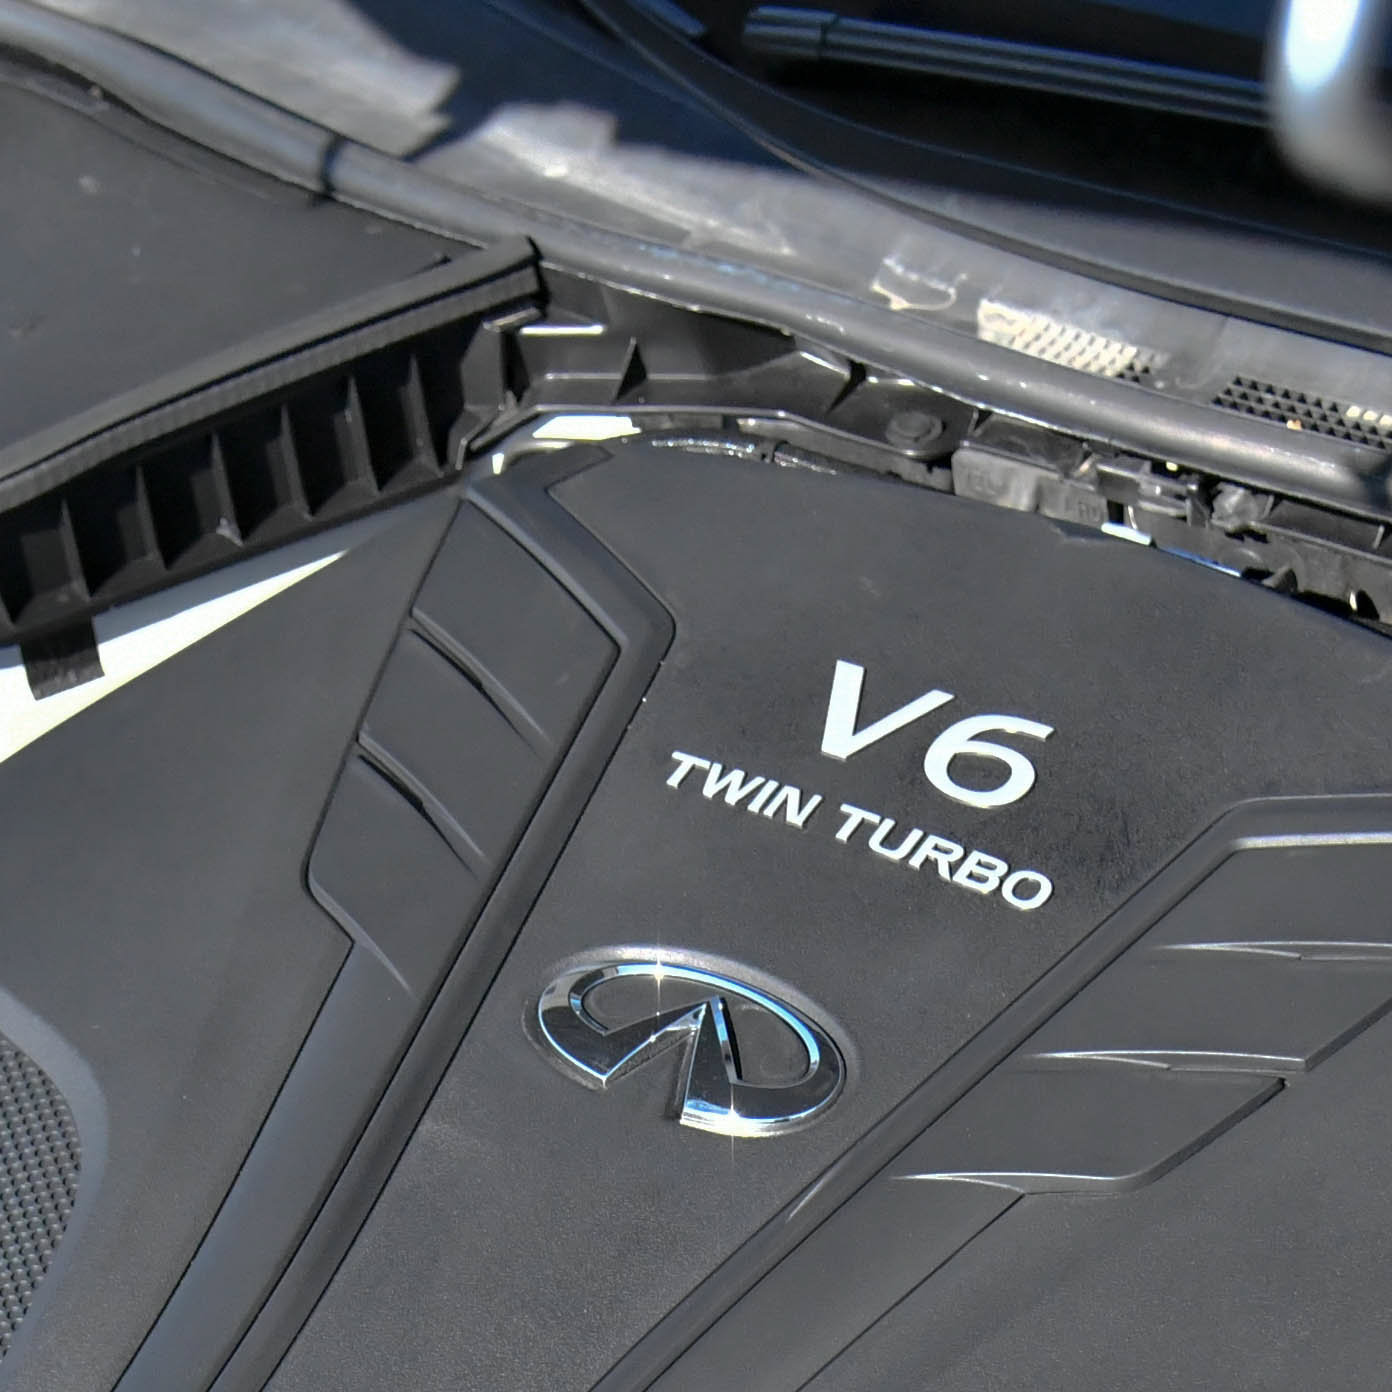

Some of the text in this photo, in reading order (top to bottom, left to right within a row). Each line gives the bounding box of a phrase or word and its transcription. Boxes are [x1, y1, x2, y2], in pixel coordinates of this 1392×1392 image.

[820, 659, 1055, 809] V6
[665, 750, 1055, 911] TWIN TURBO
